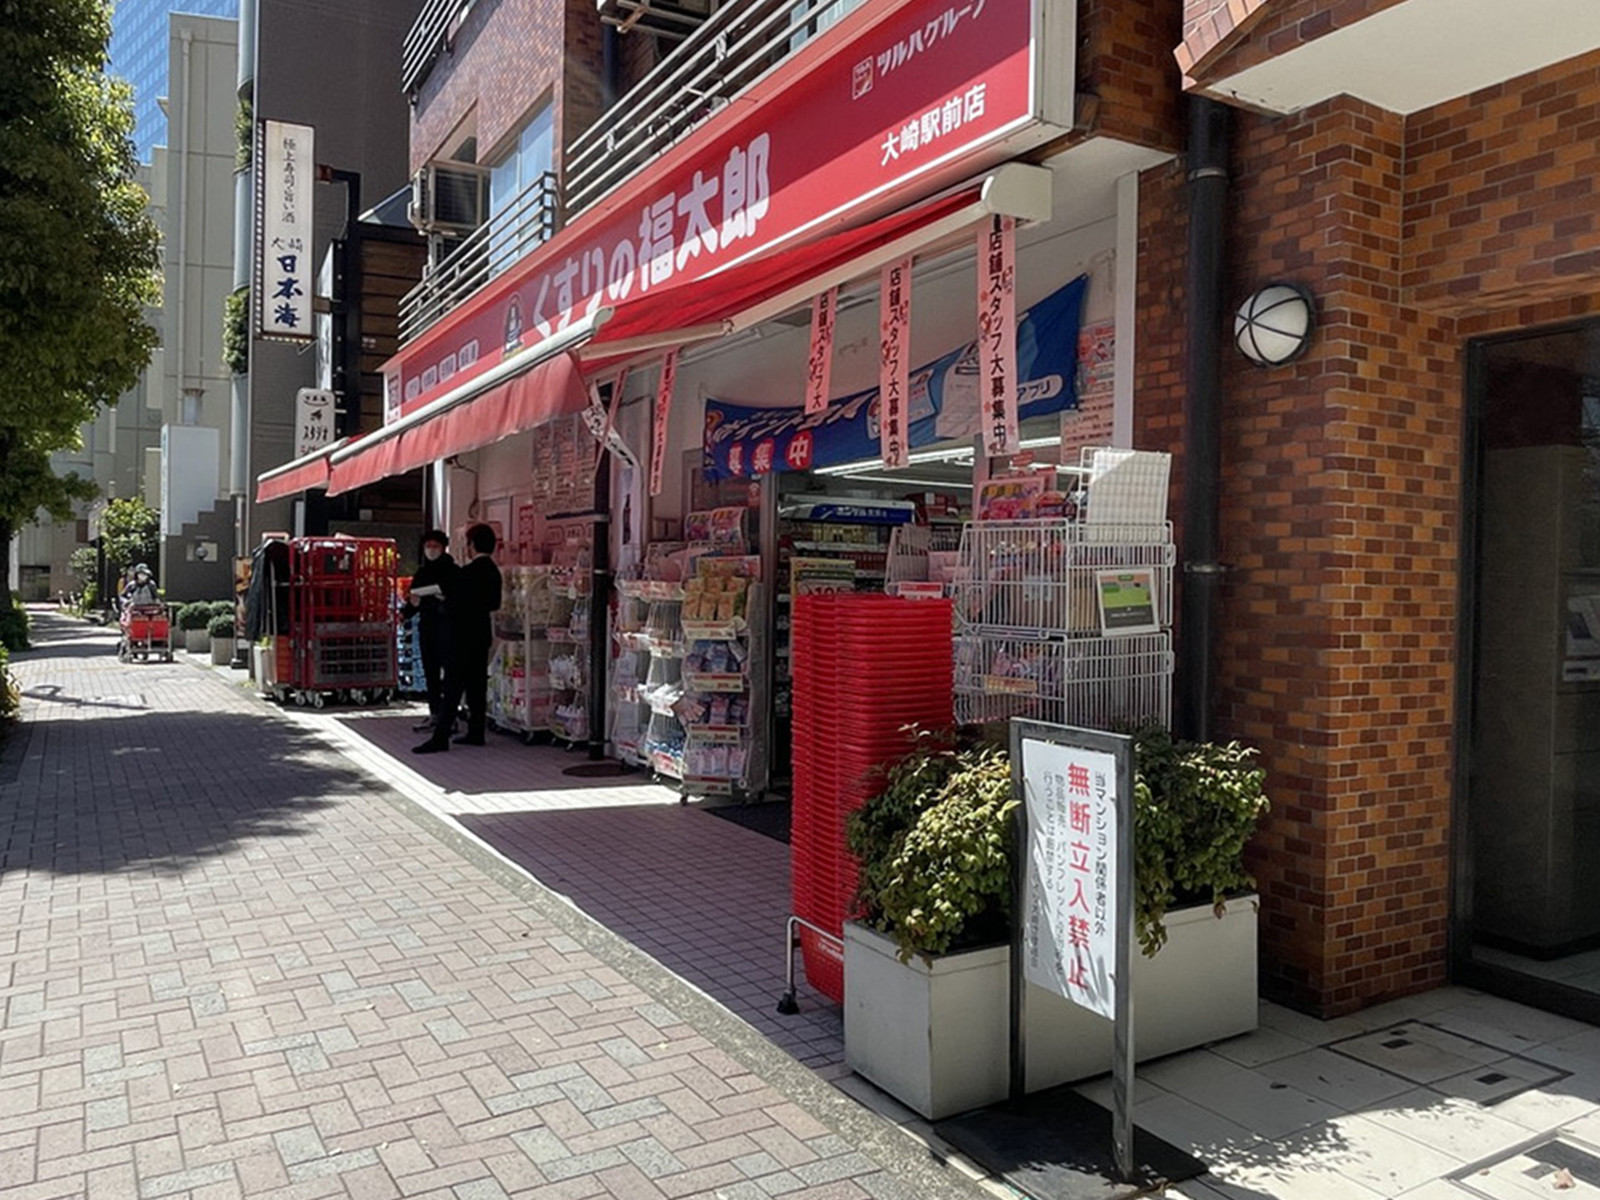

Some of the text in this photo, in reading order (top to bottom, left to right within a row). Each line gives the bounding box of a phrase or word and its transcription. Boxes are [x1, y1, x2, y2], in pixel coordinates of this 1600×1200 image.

[881, 83, 986, 166] 大崎駅前店
[272, 255, 303, 328] 日本海
[533, 132, 771, 338] くすりの福太郎
[988, 231, 1006, 441] 店舗スタッフ大募集中
[1068, 763, 1092, 990] 無断立入禁止
[1095, 771, 1107, 937] 当マンション関係者以外
